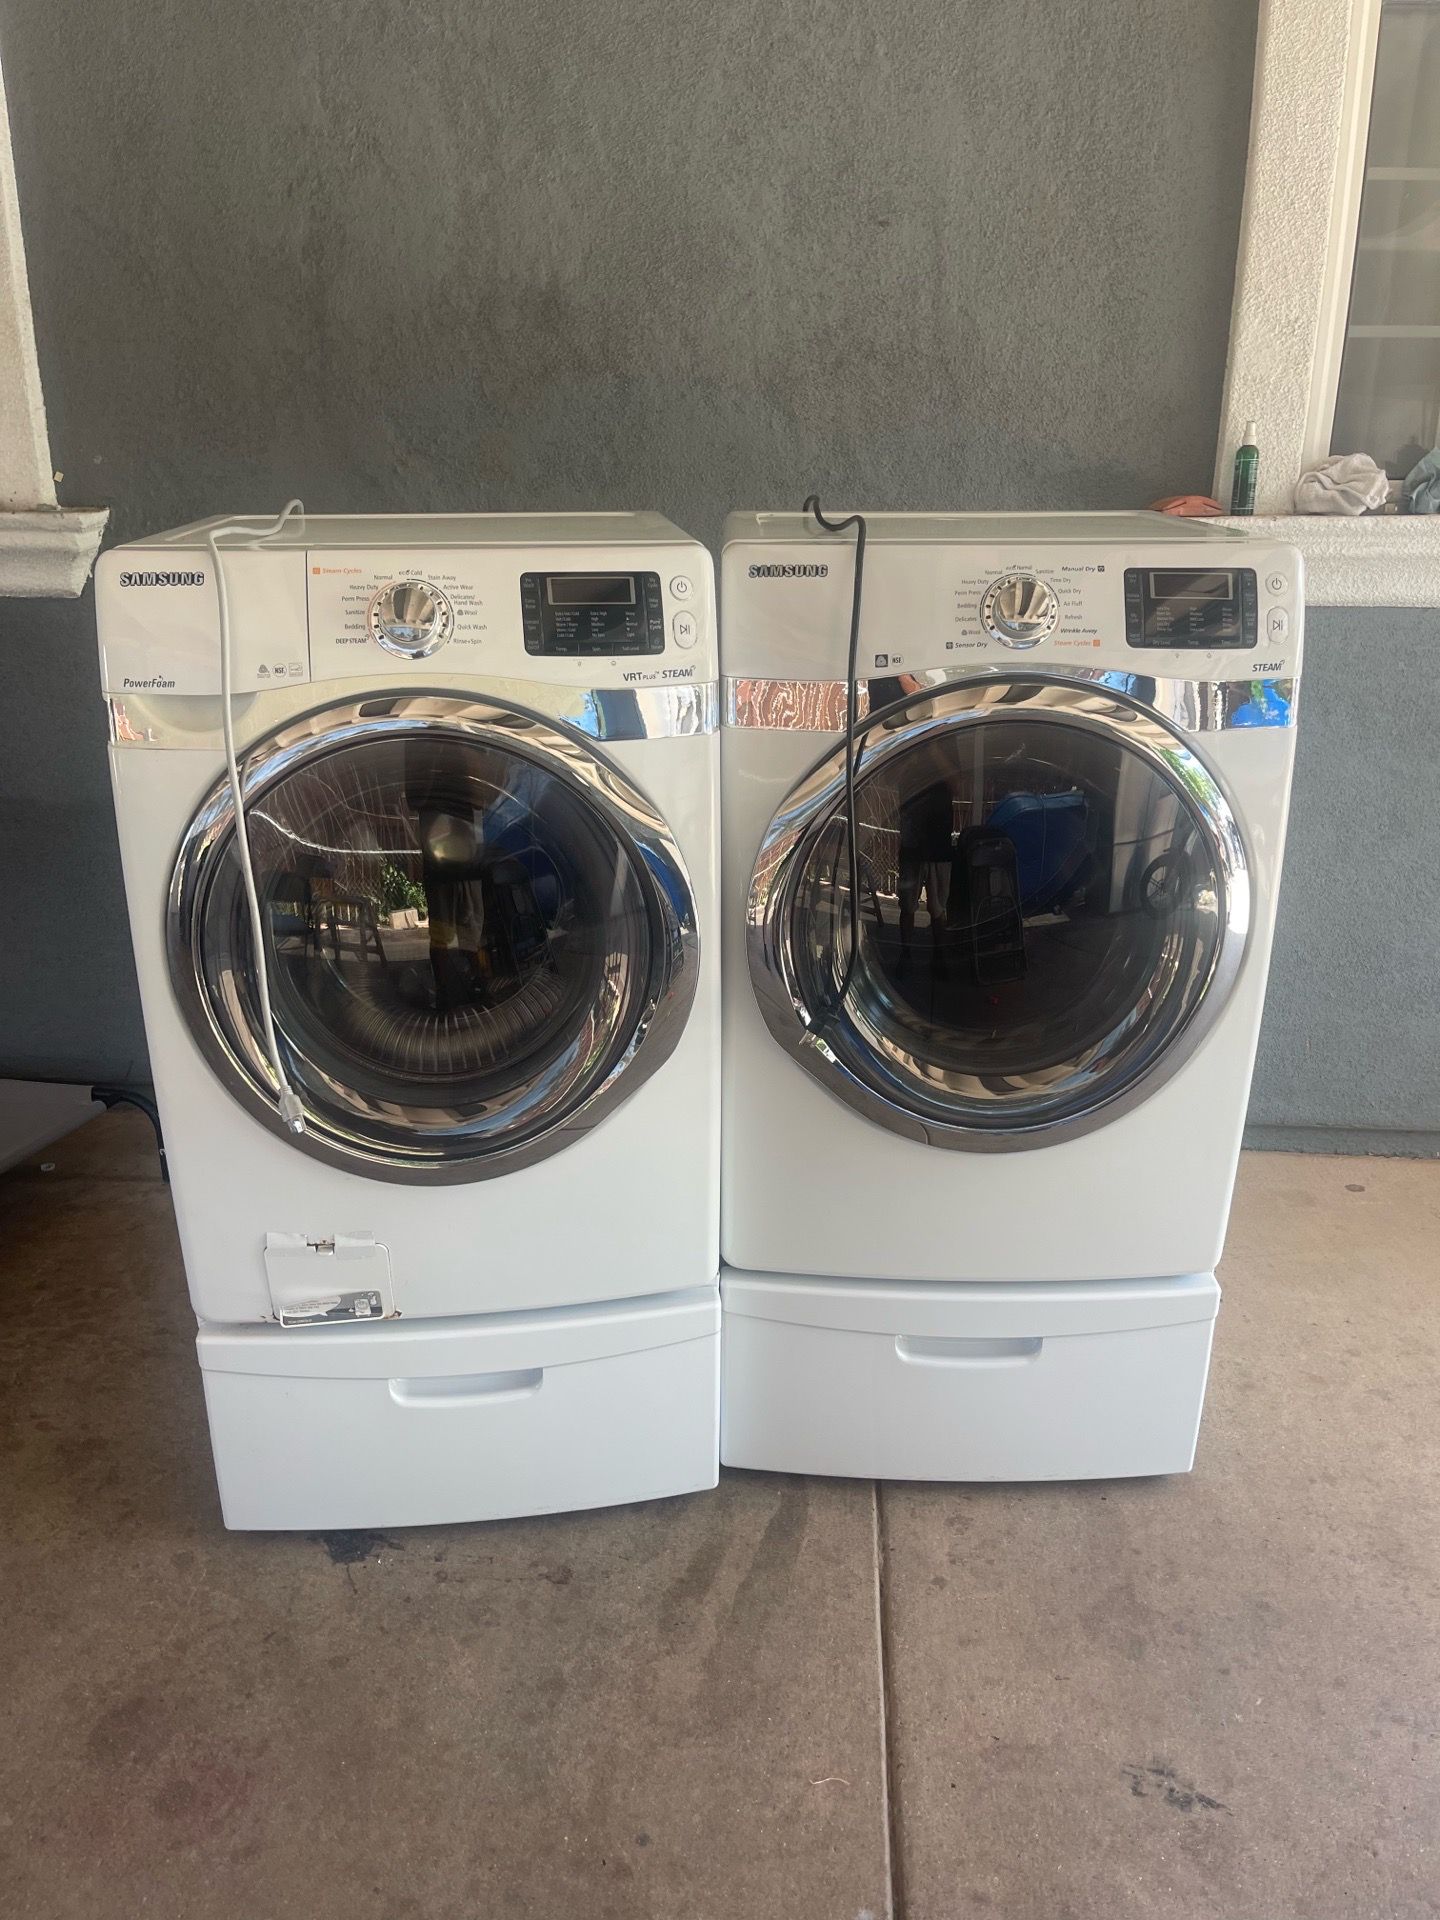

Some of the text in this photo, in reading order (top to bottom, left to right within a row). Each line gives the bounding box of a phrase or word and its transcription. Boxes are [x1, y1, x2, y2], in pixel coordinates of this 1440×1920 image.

[343, 568, 363, 576] Cycles
[748, 565, 829, 578] SAMSUNG
[1085, 565, 1096, 573] Dry
[119, 572, 205, 587] SAMSUNG
[344, 623, 367, 631] Bedding
[976, 641, 989, 649] Dry
[1251, 662, 1282, 673] STEAM
[622, 672, 643, 682] VRT
[662, 668, 693, 679] STEAM
[123, 677, 176, 689] PowerFoam
